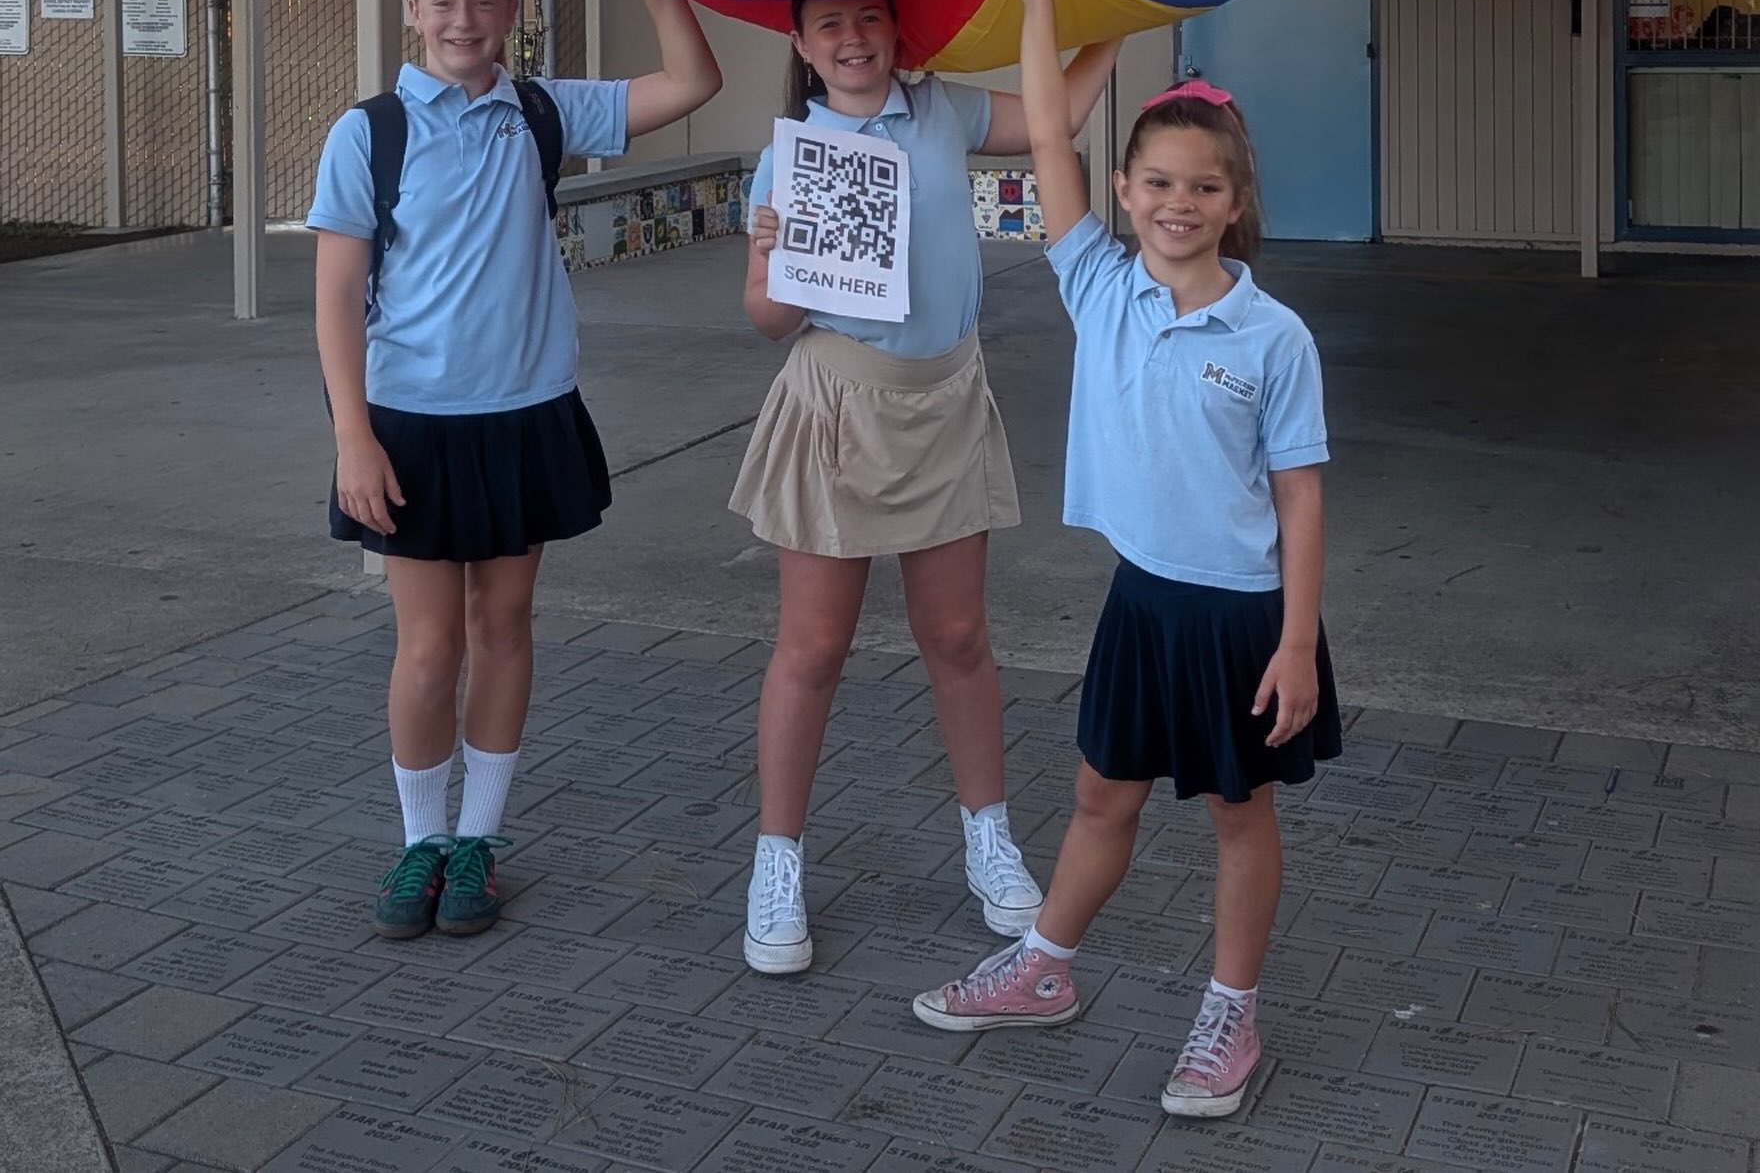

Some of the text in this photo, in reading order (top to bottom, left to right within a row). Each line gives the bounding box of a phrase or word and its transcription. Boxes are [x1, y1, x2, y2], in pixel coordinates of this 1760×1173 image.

[784, 265, 888, 298] SCAN HERE
[1202, 362, 1226, 384] M
[249, 1014, 350, 1038] STAR Mission
[247, 1046, 270, 1054] CAN
[363, 1035, 470, 1061] STAR Mission
[514, 1076, 548, 1087] 2022
[883, 1066, 1003, 1095] STAR Mission
[919, 1082, 956, 1094] 2020
[1280, 1068, 1410, 1097] STAR Mission
[378, 1087, 410, 1098] Family
[611, 1086, 730, 1117] STAR Mission
[443, 1101, 471, 1112] Thank
[471, 1109, 494, 1117] you
[522, 1120, 541, 1128] our
[644, 1104, 681, 1115] 2022
[1022, 1094, 1150, 1124] STAR Mission
[1061, 1111, 1100, 1123] 2022
[1432, 1096, 1568, 1122] STAR Mission
[1477, 1112, 1518, 1122] 2022
[336, 1111, 450, 1143] STAR Mission
[364, 1130, 401, 1142] 2022
[746, 1117, 870, 1149] STAR Mission
[734, 1140, 789, 1156] Education
[802, 1155, 822, 1163] the
[780, 1136, 820, 1148] 2022
[1448, 1137, 1479, 1146] Class
[307, 1144, 329, 1153] The
[363, 1159, 399, 1172] Family
[467, 1141, 588, 1173] STAR Mission
[735, 1150, 763, 1160] thing
[766, 1156, 788, 1164] that
[887, 1148, 931, 1162] STAR
[1323, 1153, 1370, 1166] STAR
[498, 1160, 537, 1173] 2022
